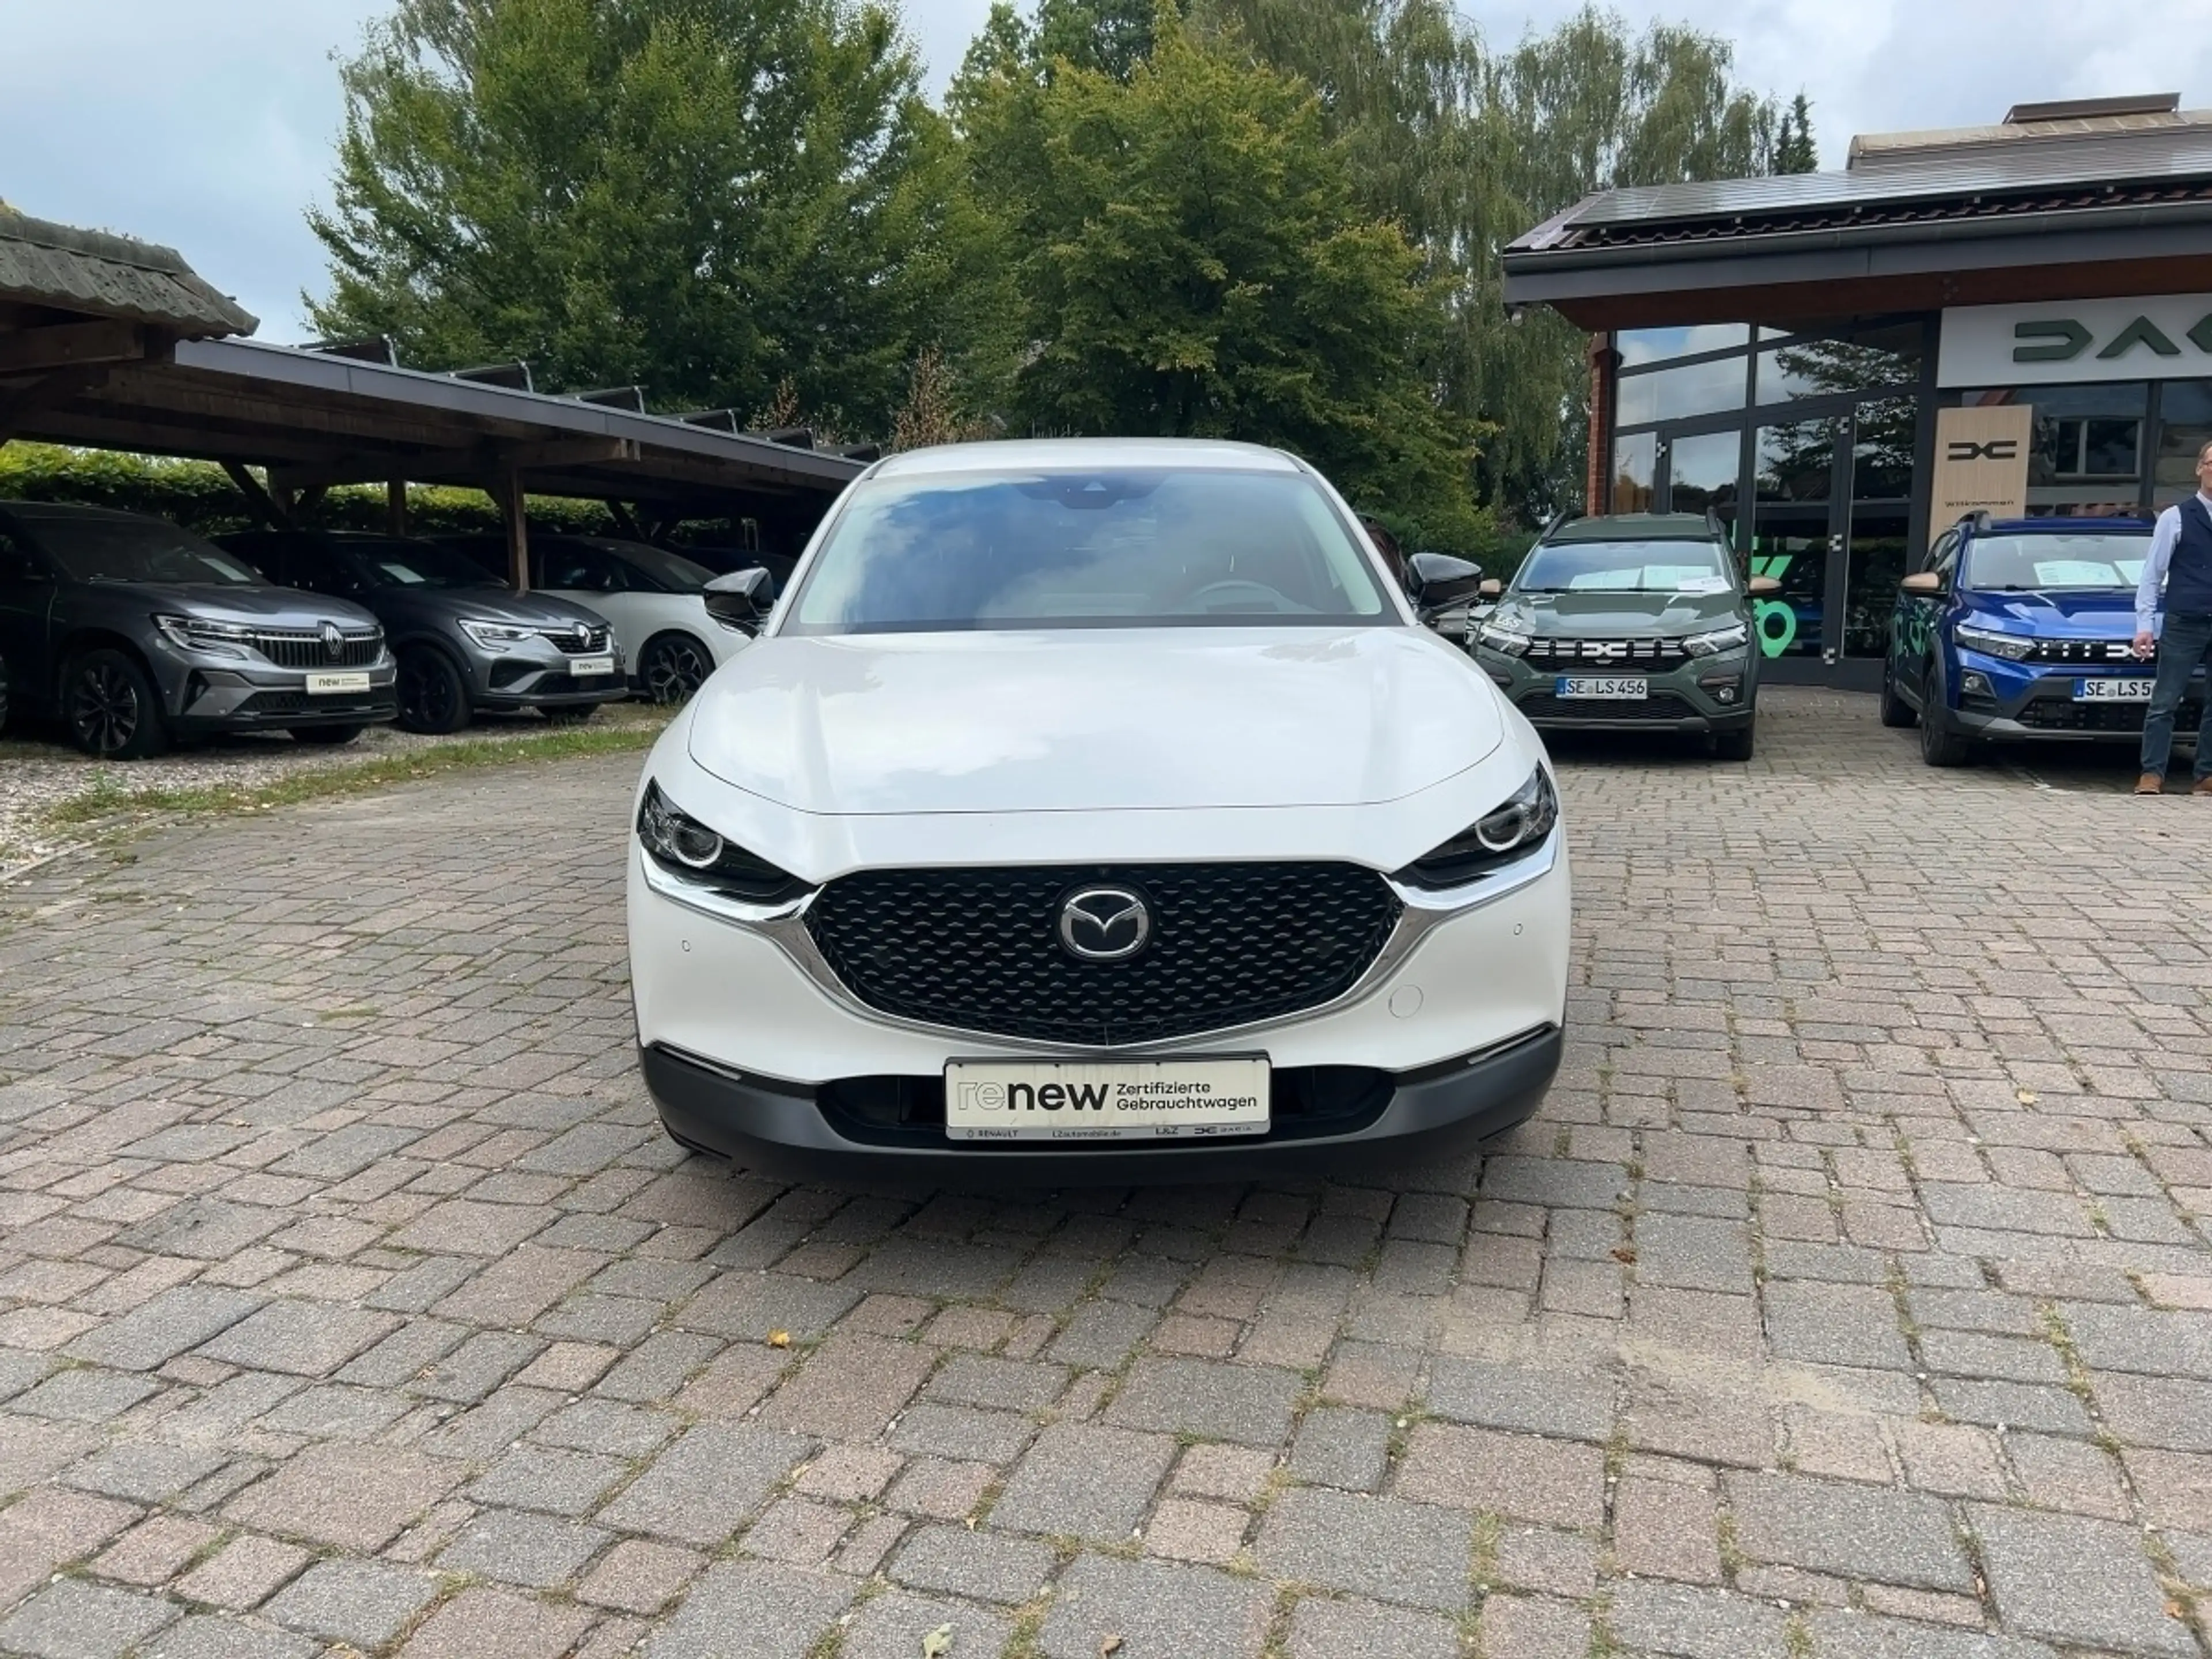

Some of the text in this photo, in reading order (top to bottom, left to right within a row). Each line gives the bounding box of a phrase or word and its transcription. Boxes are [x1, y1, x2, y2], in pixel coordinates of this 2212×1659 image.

[1567, 680, 1645, 694] SE LS 456
[2086, 682, 2105, 696] SE
[2118, 682, 2138, 696] LS
[1116, 1081, 1211, 1096] Zertifizierte
[957, 1082, 1109, 1111] renew
[1116, 1096, 1257, 1111] Gebrauchtwagen
[978, 1130, 1018, 1138] RENAULT
